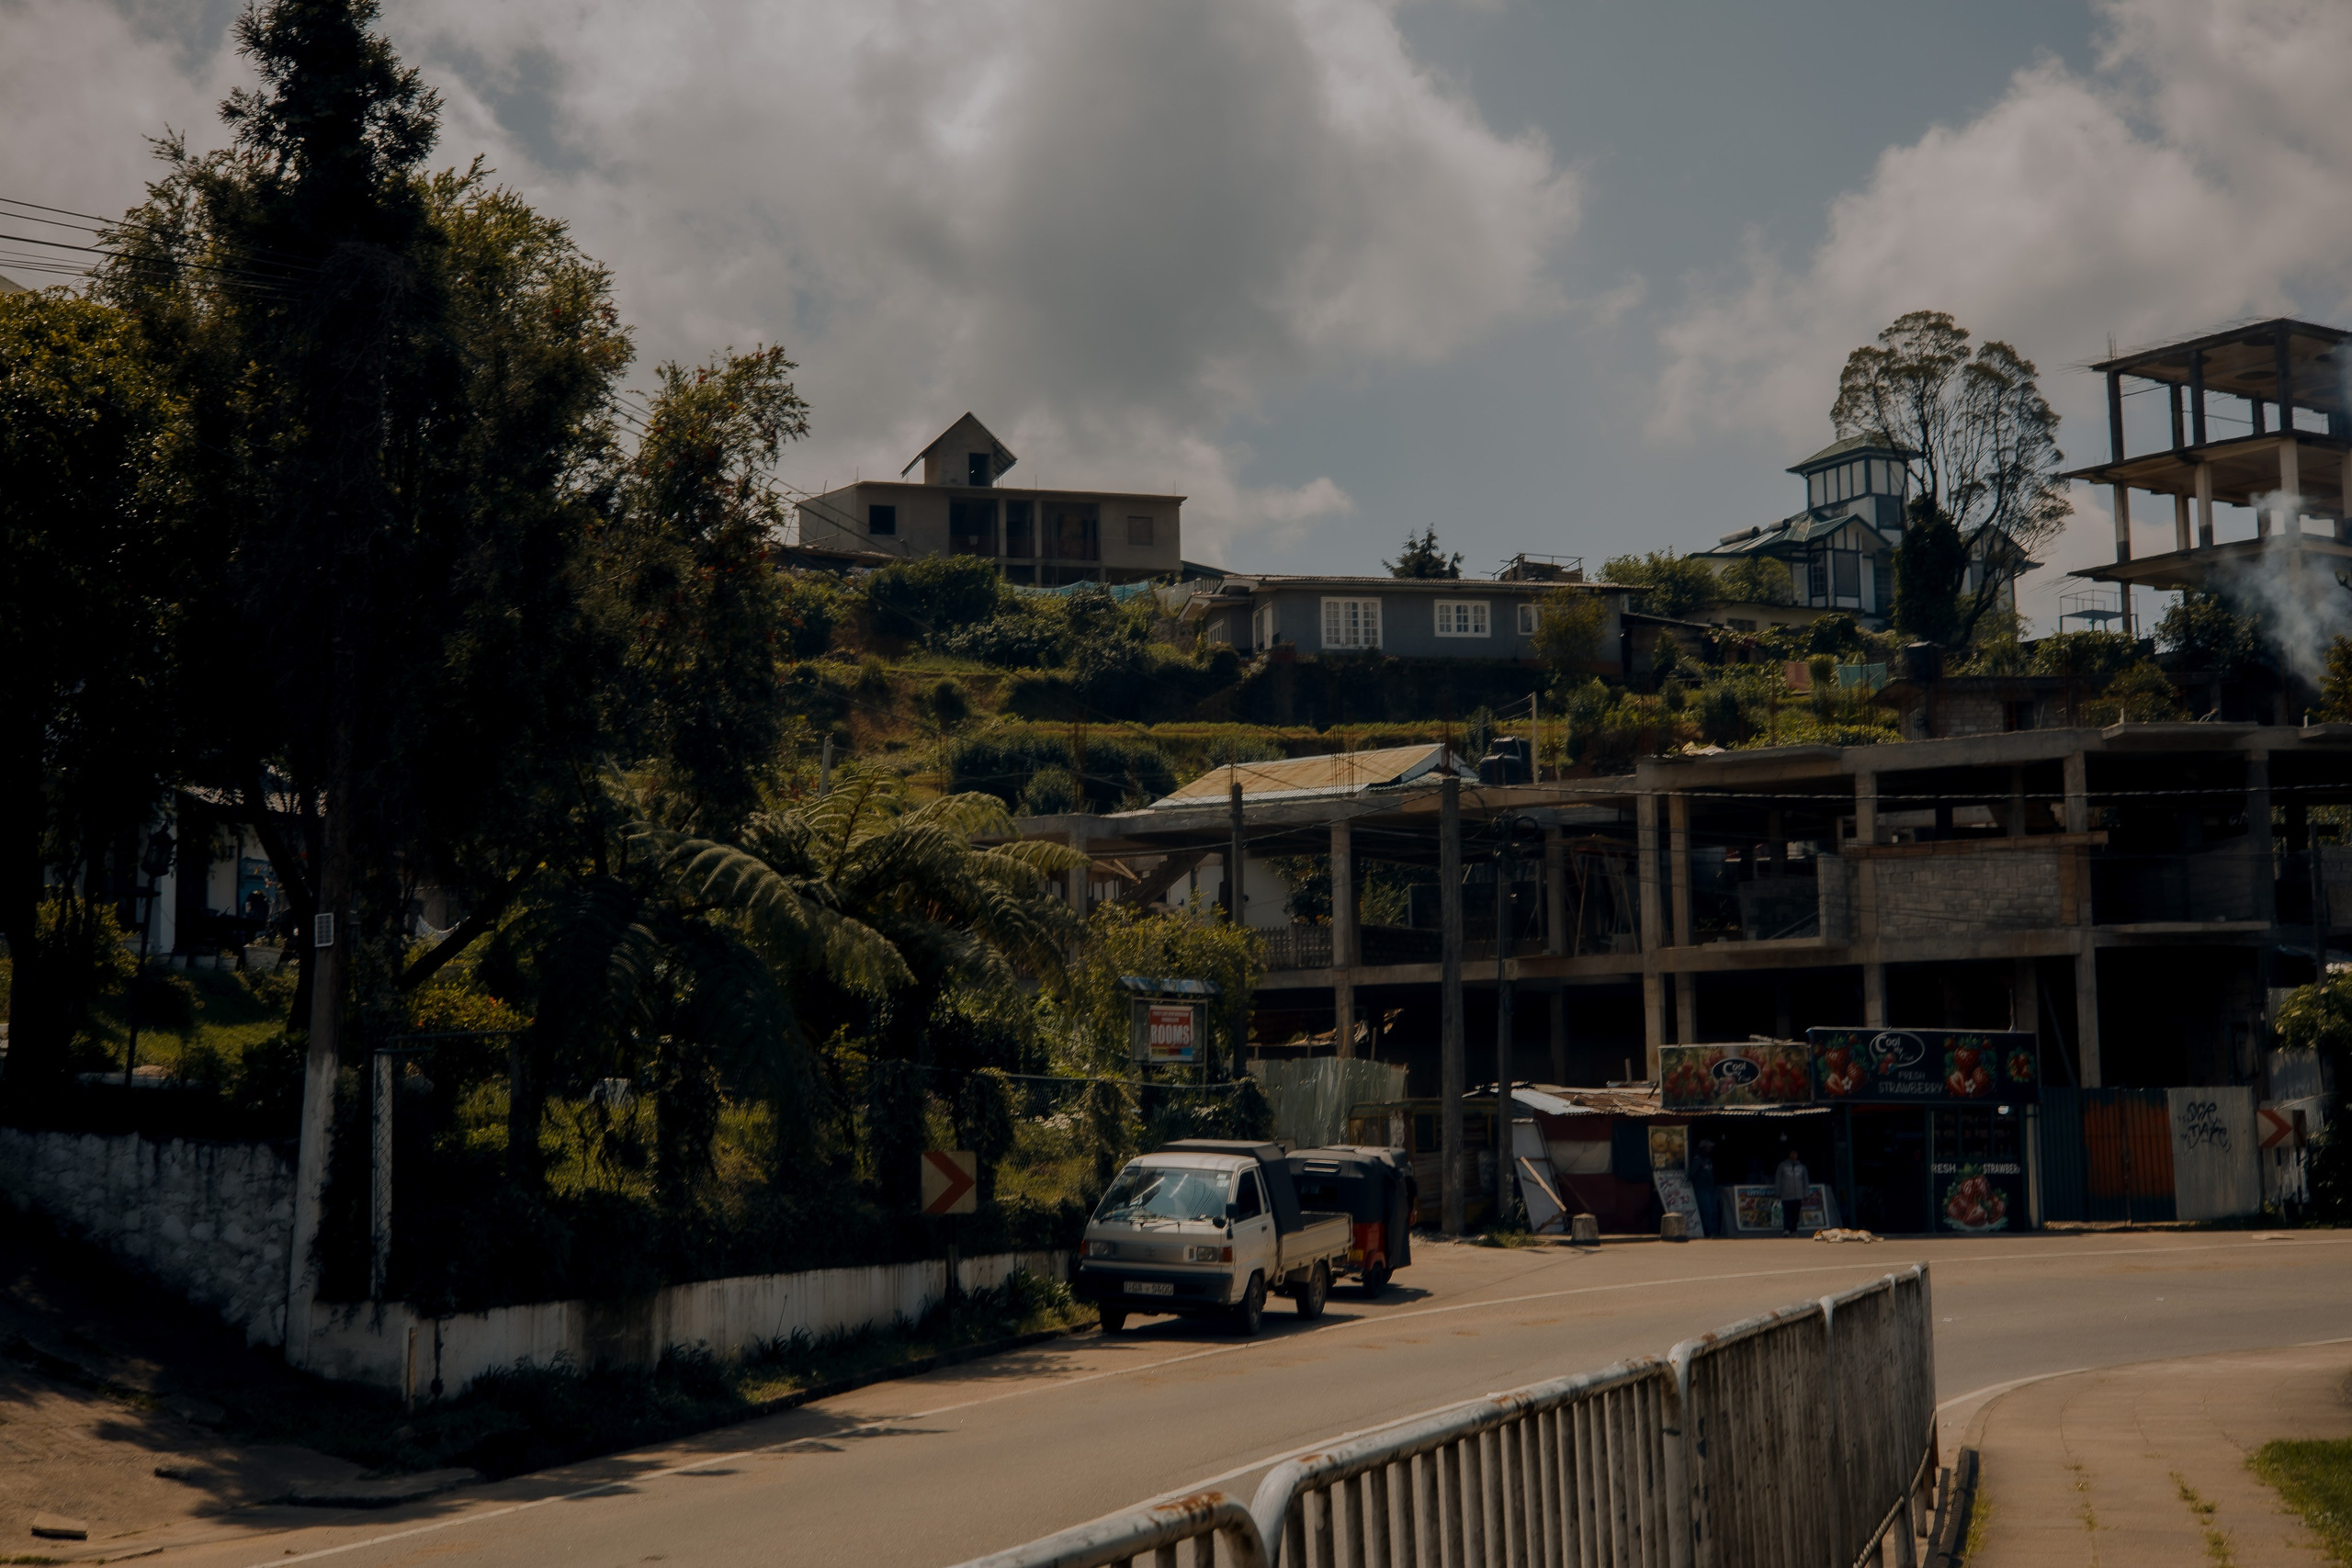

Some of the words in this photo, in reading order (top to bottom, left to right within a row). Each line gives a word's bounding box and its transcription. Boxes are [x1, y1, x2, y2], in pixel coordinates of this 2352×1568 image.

[1150, 1024, 1190, 1044] ROOMS
[1874, 1035, 1901, 1053] Cool
[1723, 1061, 1747, 1077] Cool
[1898, 1070, 1926, 1080] FRESH
[1878, 1081, 1944, 1095] STRAWBERRY
[1930, 1162, 1957, 1174] RESH
